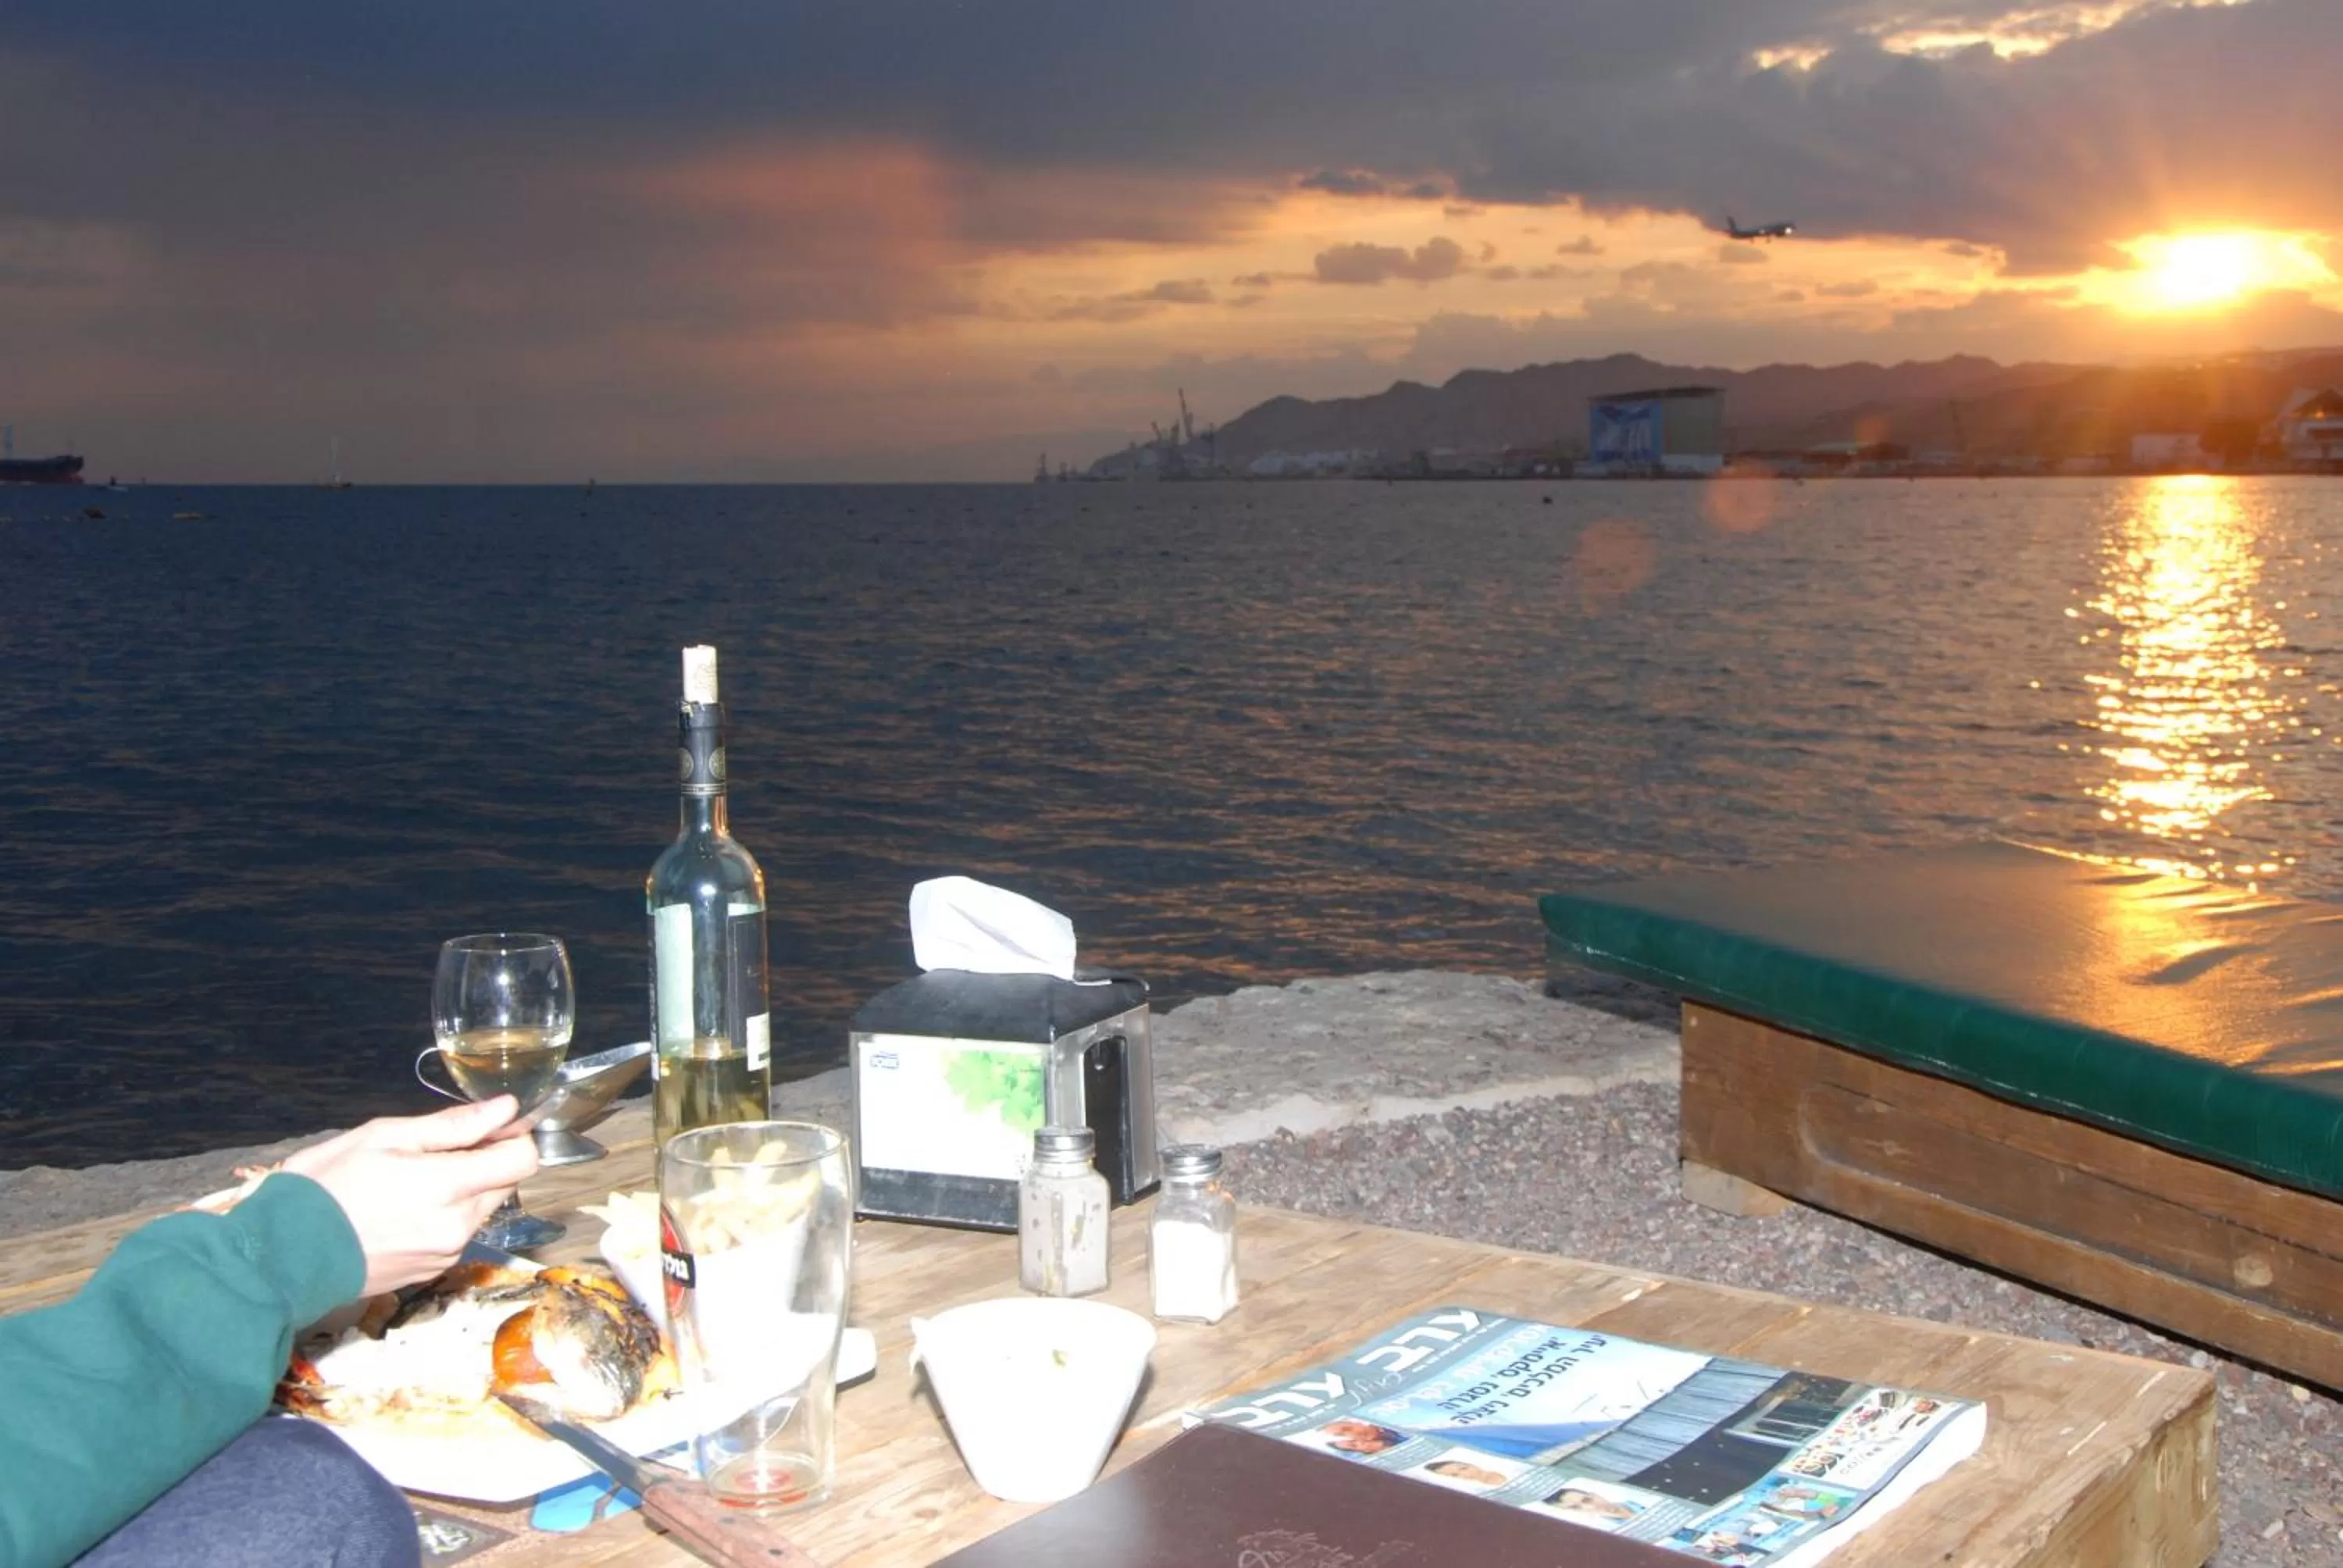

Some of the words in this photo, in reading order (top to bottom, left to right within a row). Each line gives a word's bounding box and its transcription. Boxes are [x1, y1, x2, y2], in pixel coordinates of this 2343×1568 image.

[1355, 1309, 1481, 1373] ערב
[1211, 1371, 1345, 1427] ערב
[1436, 1381, 1500, 1410] נסגרה
